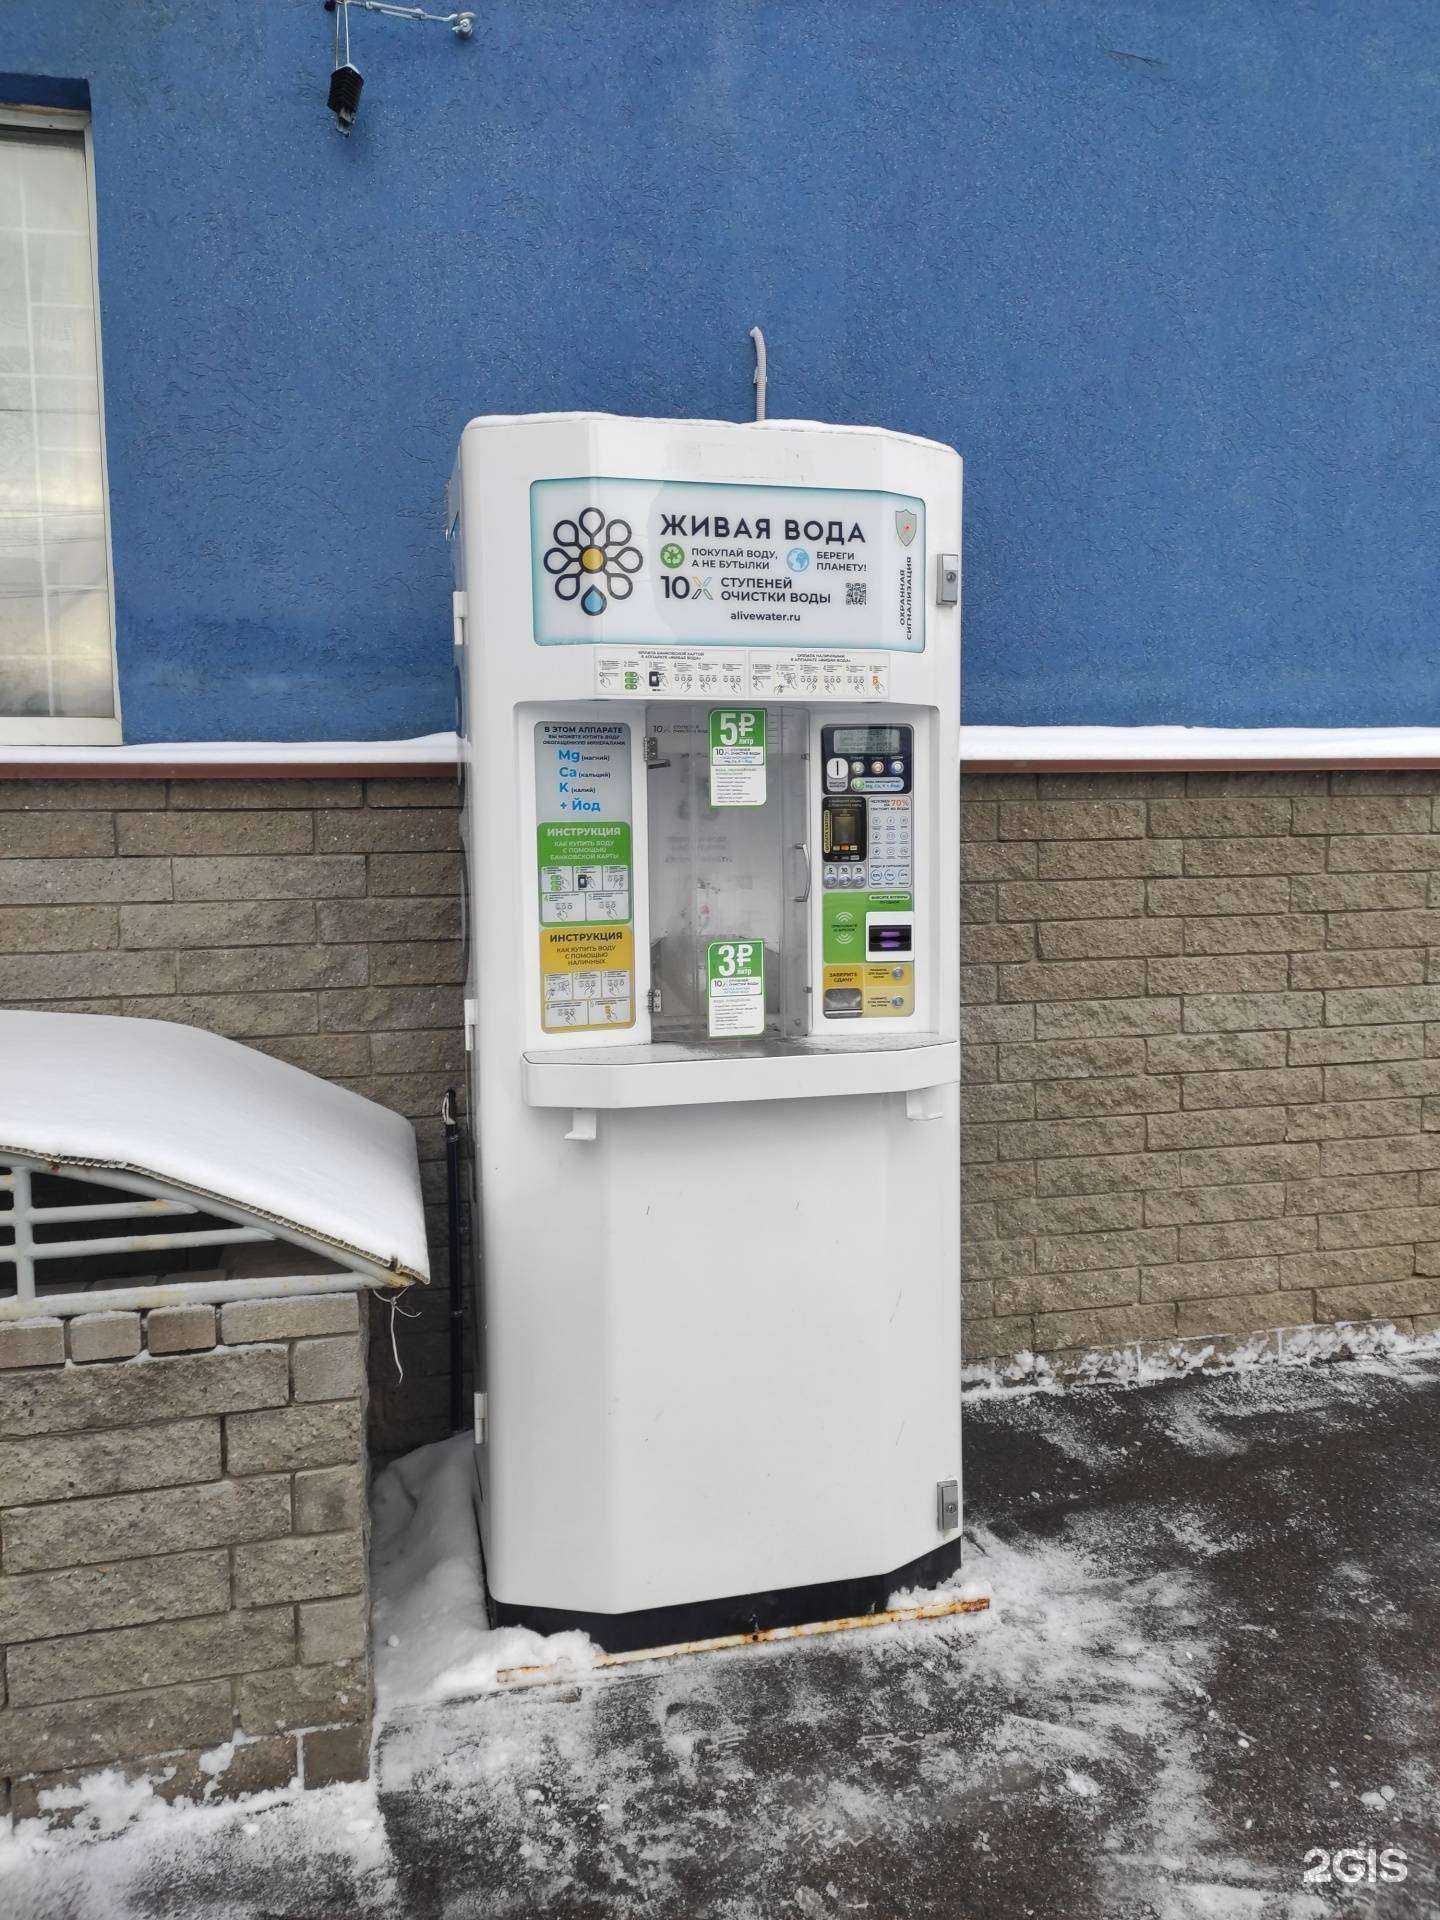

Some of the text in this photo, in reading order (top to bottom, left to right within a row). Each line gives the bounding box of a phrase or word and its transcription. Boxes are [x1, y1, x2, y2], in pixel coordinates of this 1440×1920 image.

[660, 514, 866, 546] ЖИВАЯ ВОДА
[692, 547, 778, 560] ПОКУПАЙ ВОДУ,
[816, 552, 854, 560] БЕРЕГИ
[692, 560, 770, 570] А НЕ БУТЫЛКИ
[816, 562, 866, 572] ПЛАНЕТУ!
[721, 577, 792, 590] СТУПЕНЕЙ
[721, 591, 830, 604] ОЧИСТКИ ВОДЫ
[730, 611, 801, 622] alivewater.ru
[558, 750, 580, 762] Mg
[560, 767, 576, 778] Ca
[572, 797, 600, 812] Йод
[547, 828, 620, 838] ИНСТРУКЦИЯ
[550, 932, 623, 942] ИНСТРУКЦИЯ
